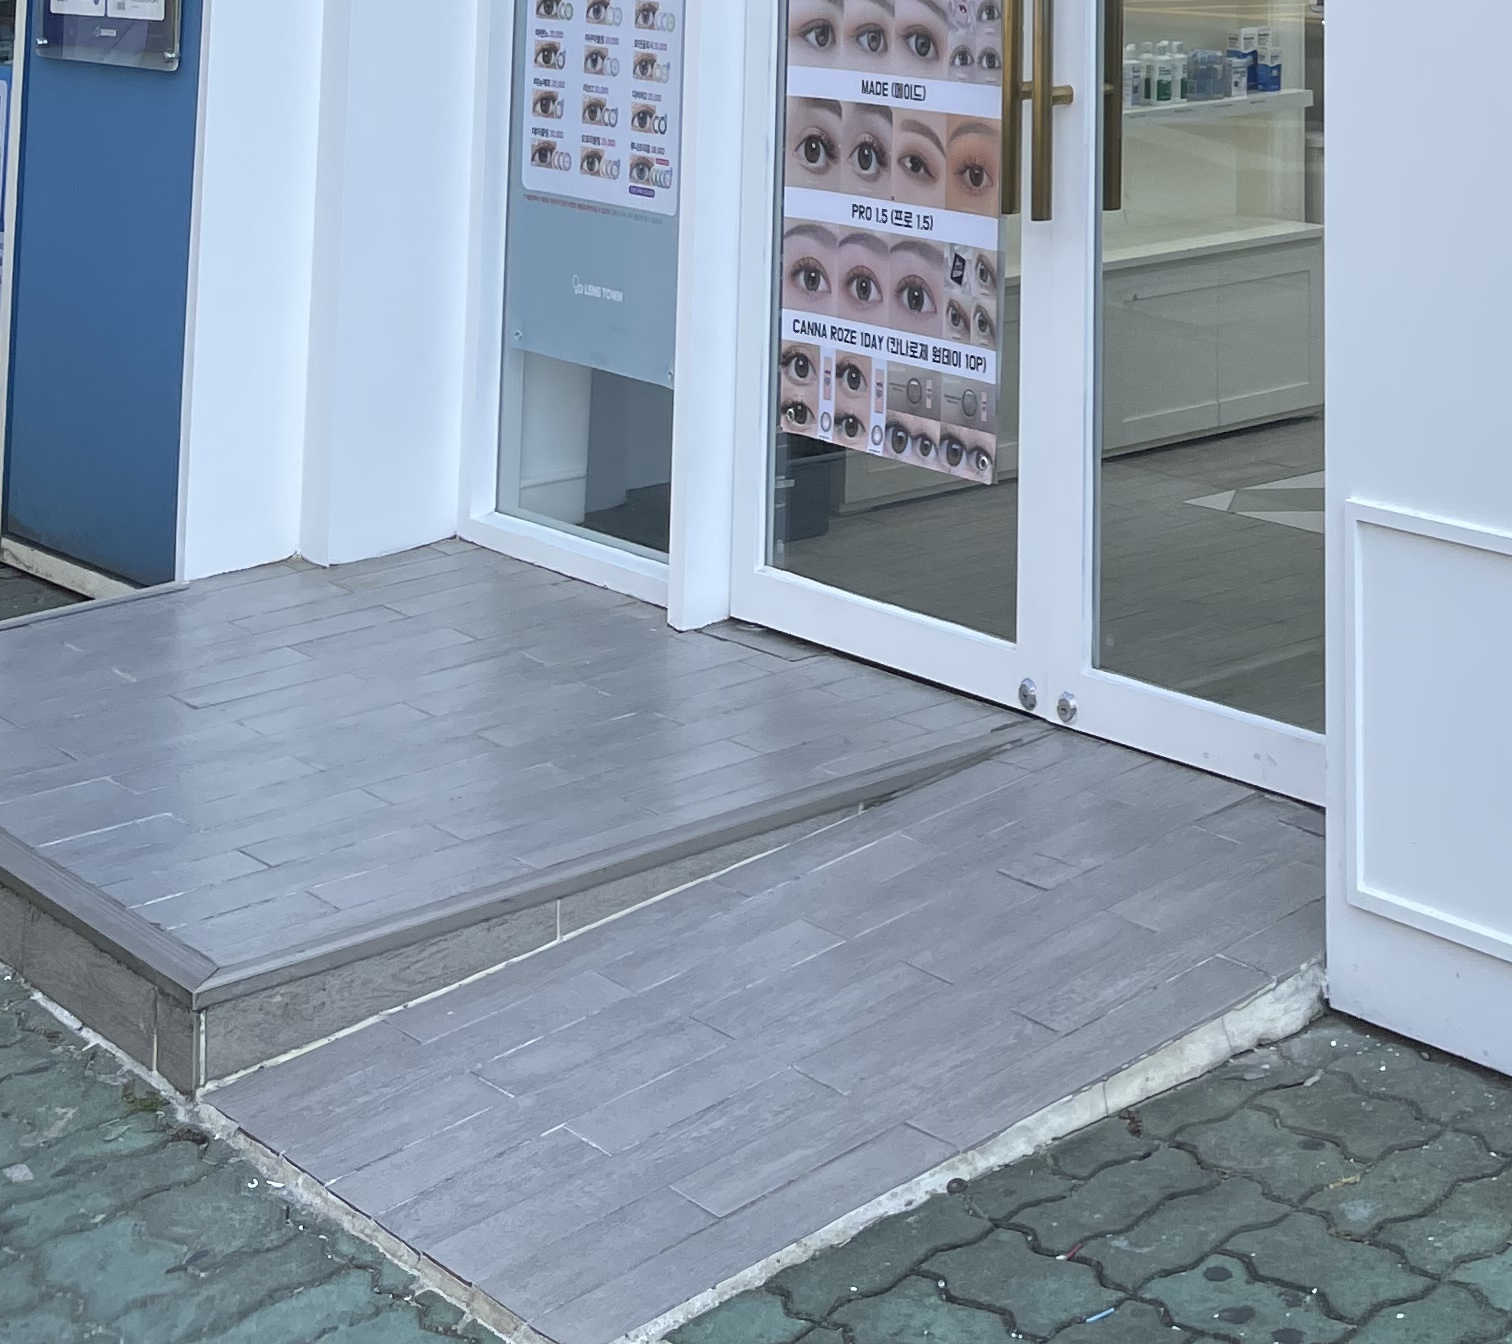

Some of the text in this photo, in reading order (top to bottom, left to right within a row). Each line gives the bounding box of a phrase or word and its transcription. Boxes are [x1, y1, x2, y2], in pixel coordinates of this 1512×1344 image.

[861, 79, 888, 97] MADE
[851, 203, 873, 222] PRO
[874, 206, 889, 224] 1.5
[915, 213, 934, 231] 1.5)
[792, 319, 828, 340] CANNA
[830, 324, 858, 345] ROZE
[860, 329, 883, 350] 1DAY
[963, 351, 987, 373] 10P)
